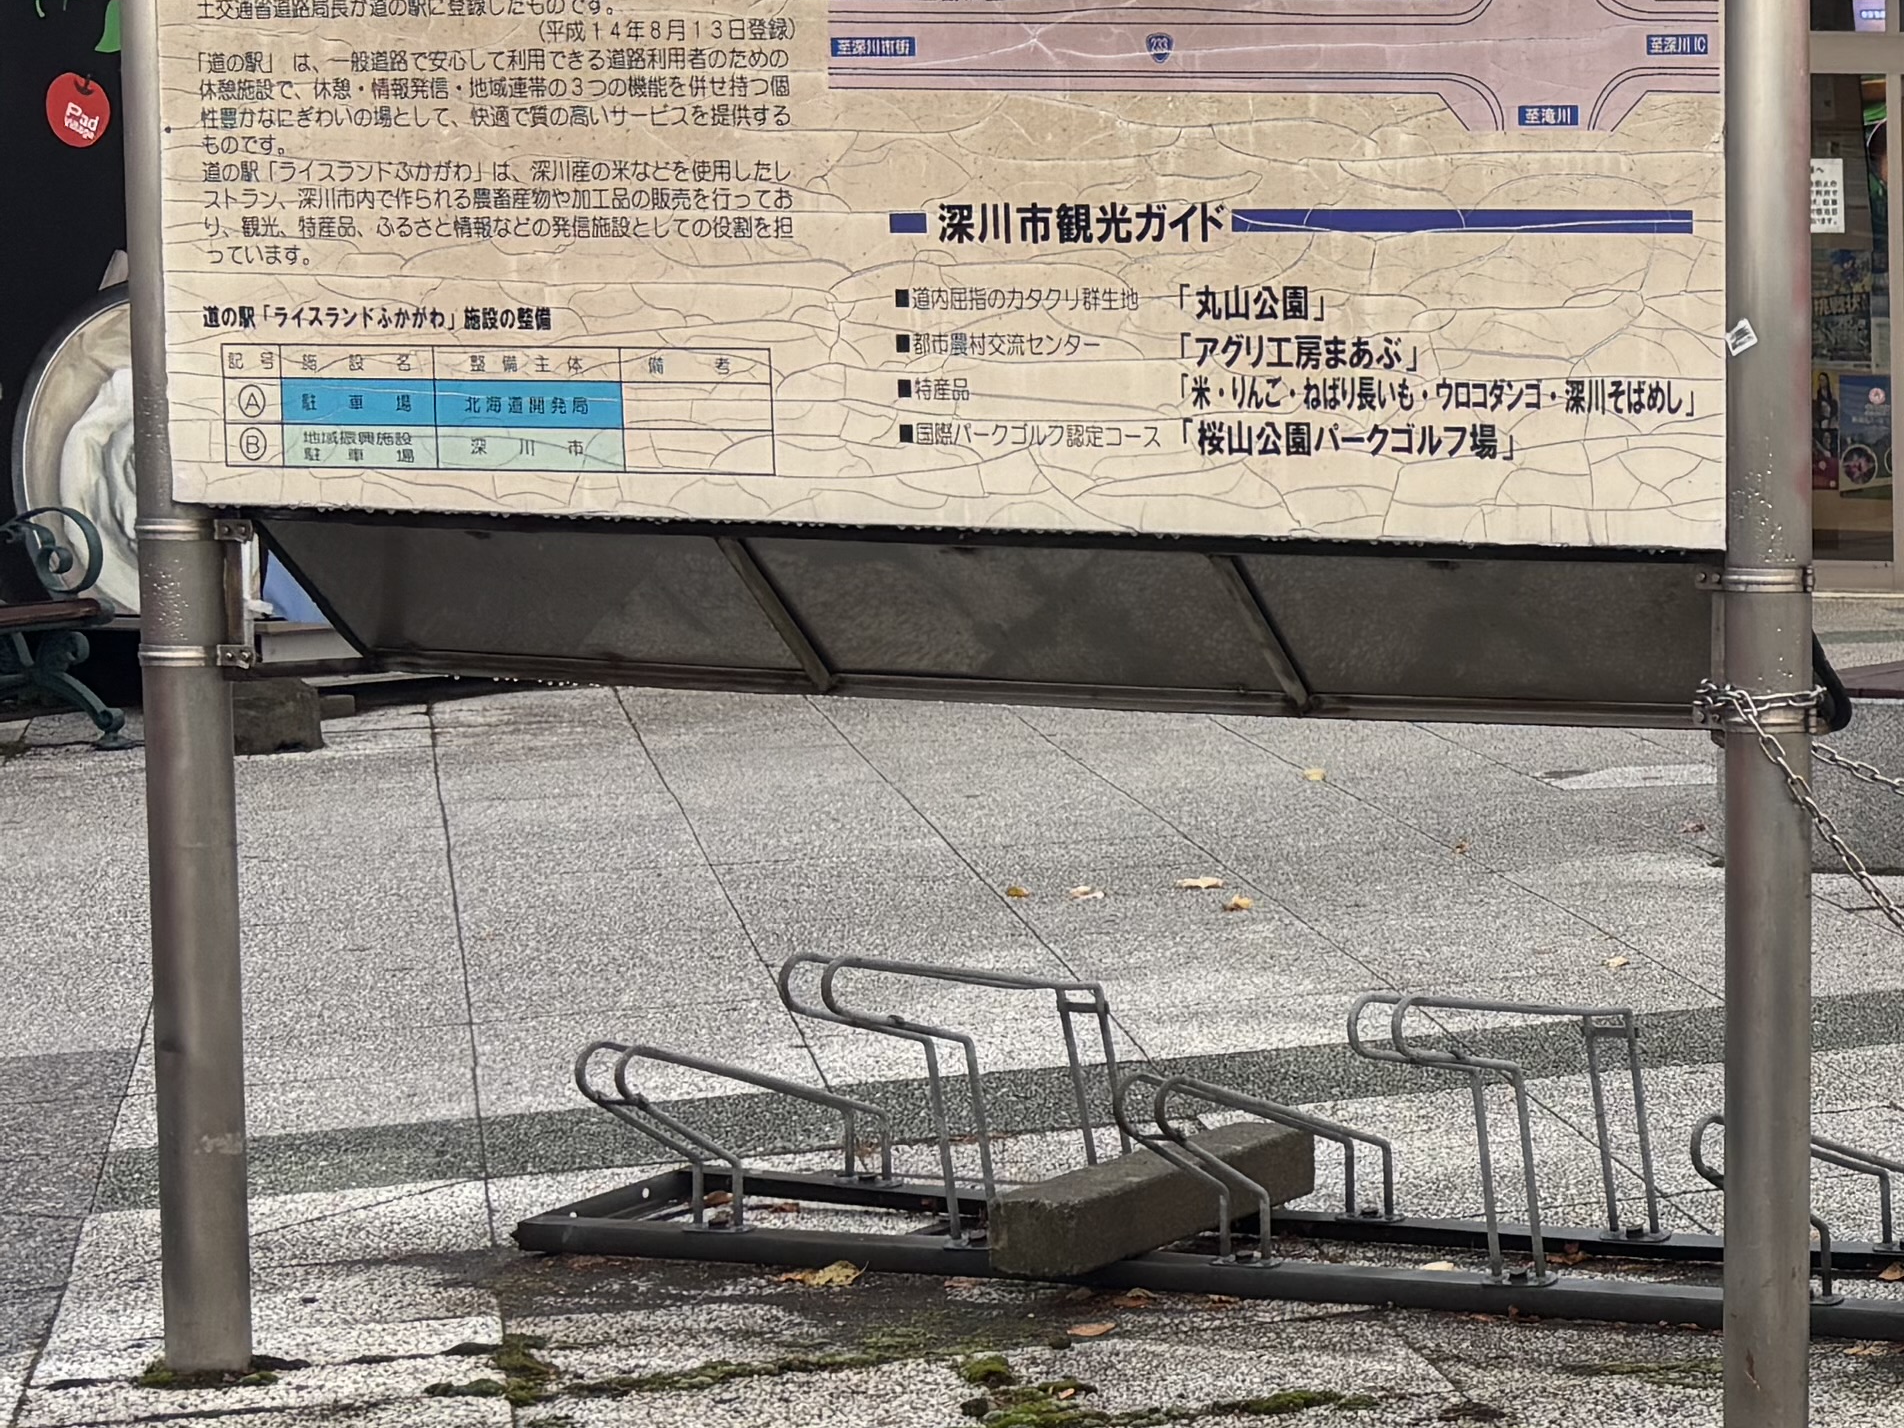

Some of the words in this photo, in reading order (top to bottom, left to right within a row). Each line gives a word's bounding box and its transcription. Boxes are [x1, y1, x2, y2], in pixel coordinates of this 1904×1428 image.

[65, 101, 100, 126] Pad
[201, 135, 286, 156] ものです。
[937, 201, 1224, 245] 深川市観光ガイド
[912, 286, 1139, 314] 道内屈指のカタクリ群生地
[1180, 283, 1327, 323] 「丸山公園」
[913, 331, 1102, 358] 都市農村交流センター
[1180, 331, 1418, 371] 「アグリ工房まあぶ」
[914, 377, 970, 402] 特産品
[464, 394, 589, 416] 北海道開発局
[1182, 418, 1516, 461] 「桜山公園パークゴルフ場」
